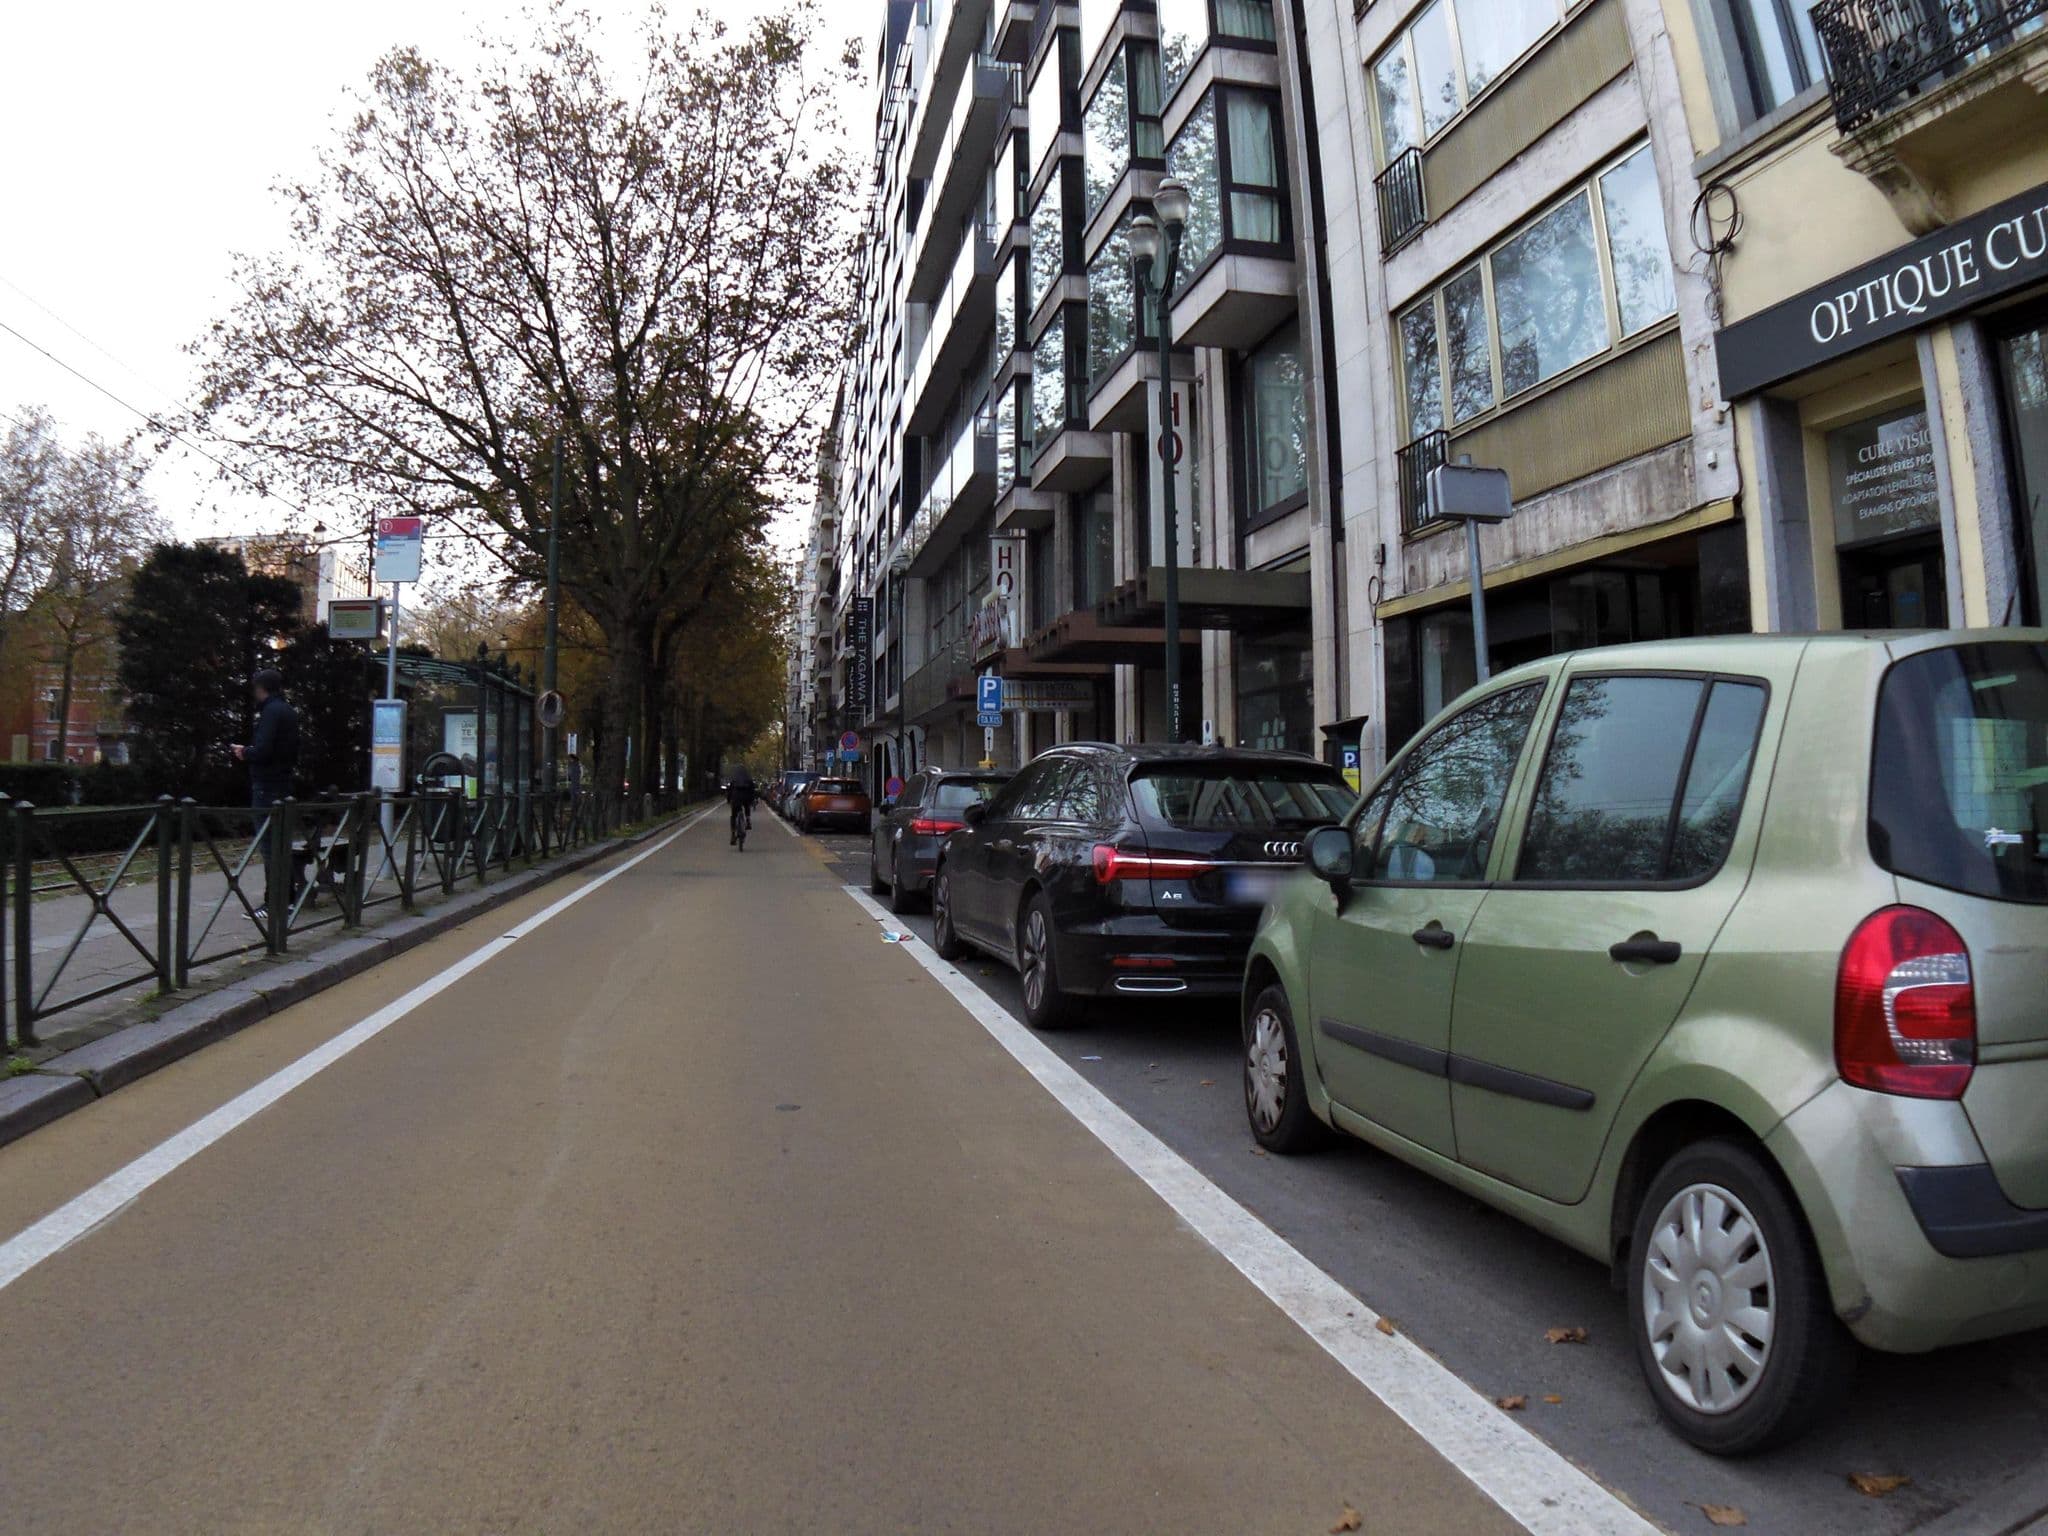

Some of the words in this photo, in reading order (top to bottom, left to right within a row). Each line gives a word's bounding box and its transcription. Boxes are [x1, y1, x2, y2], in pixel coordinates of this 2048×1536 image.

[1810, 238, 1980, 344] OPTIQUE
[1985, 204, 2048, 270] CU
[858, 618, 867, 643] THE
[858, 647, 867, 701] TAGAWA
[983, 679, 997, 698] P
[1344, 752, 1356, 768] P
